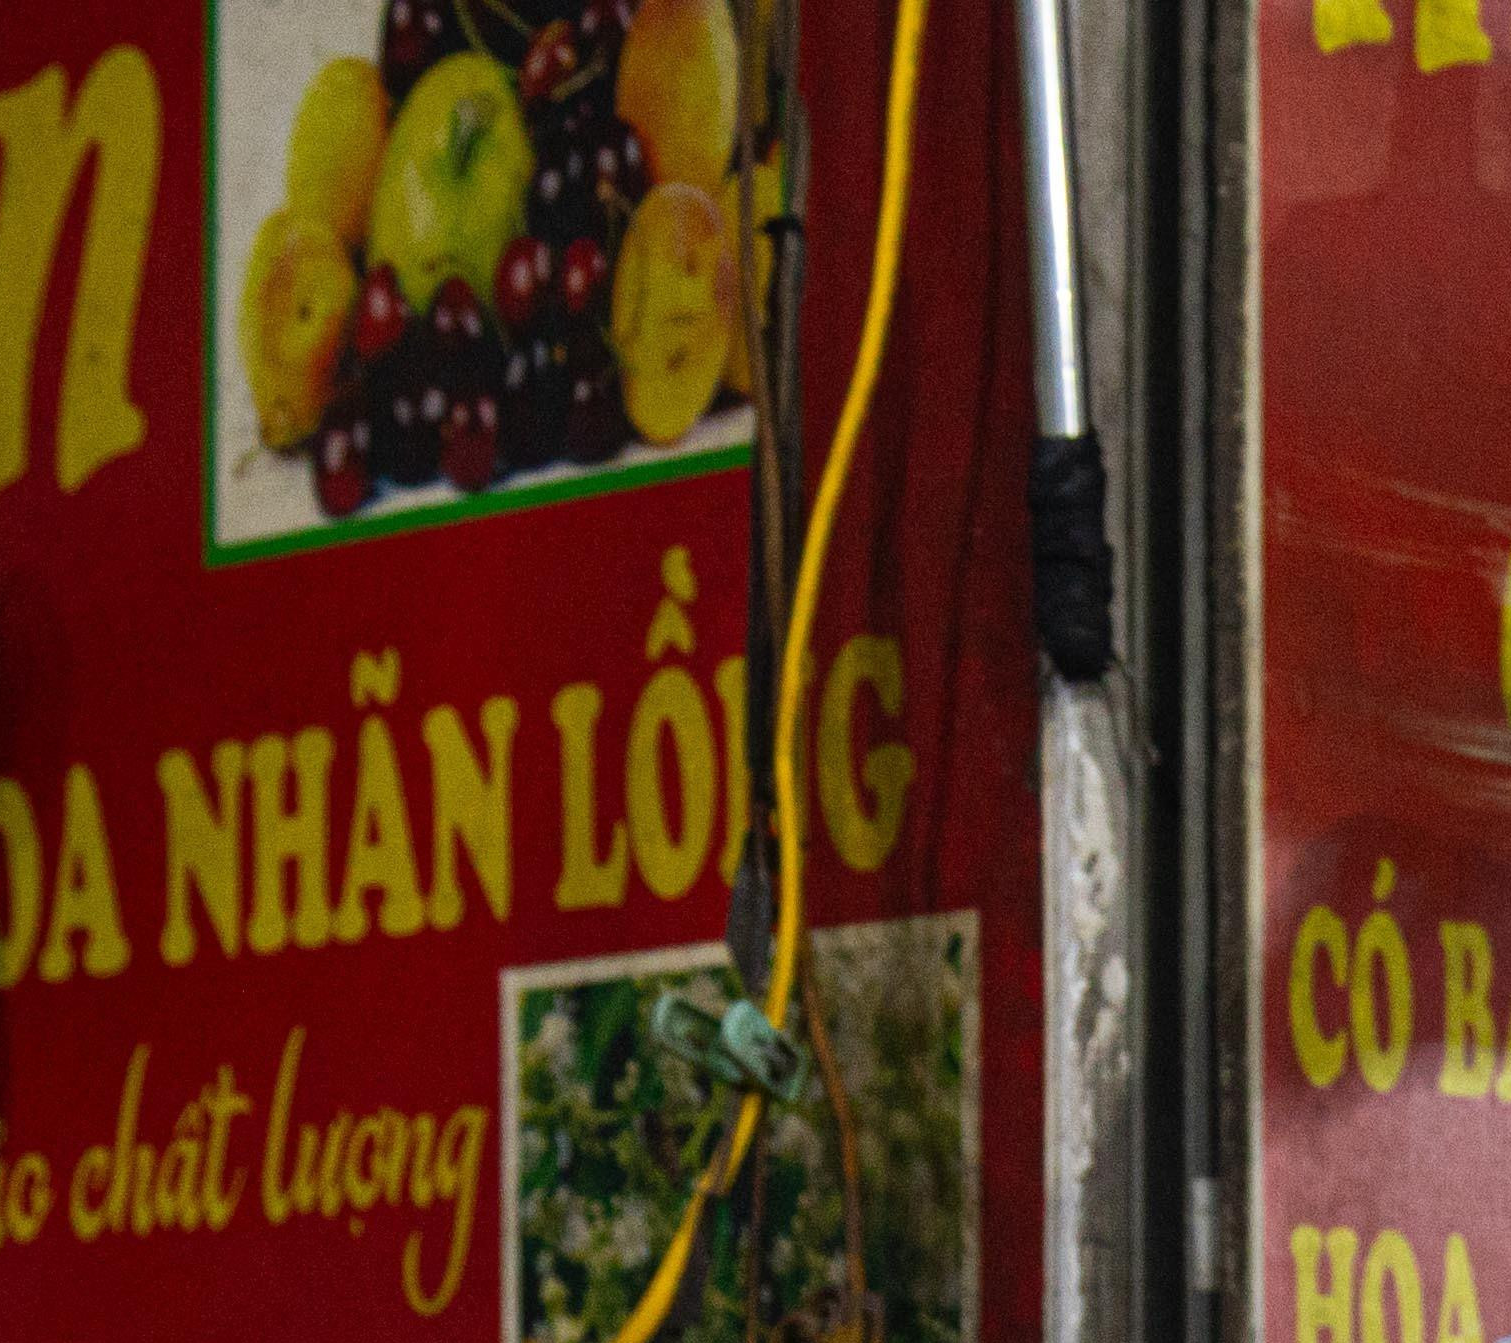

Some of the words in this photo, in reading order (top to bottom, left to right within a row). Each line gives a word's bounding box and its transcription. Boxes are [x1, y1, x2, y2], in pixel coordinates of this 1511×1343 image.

[157, 648, 519, 967] NHÃN
[1290, 857, 1415, 1094] CÓ
[263, 1025, 488, 1318] lượng
